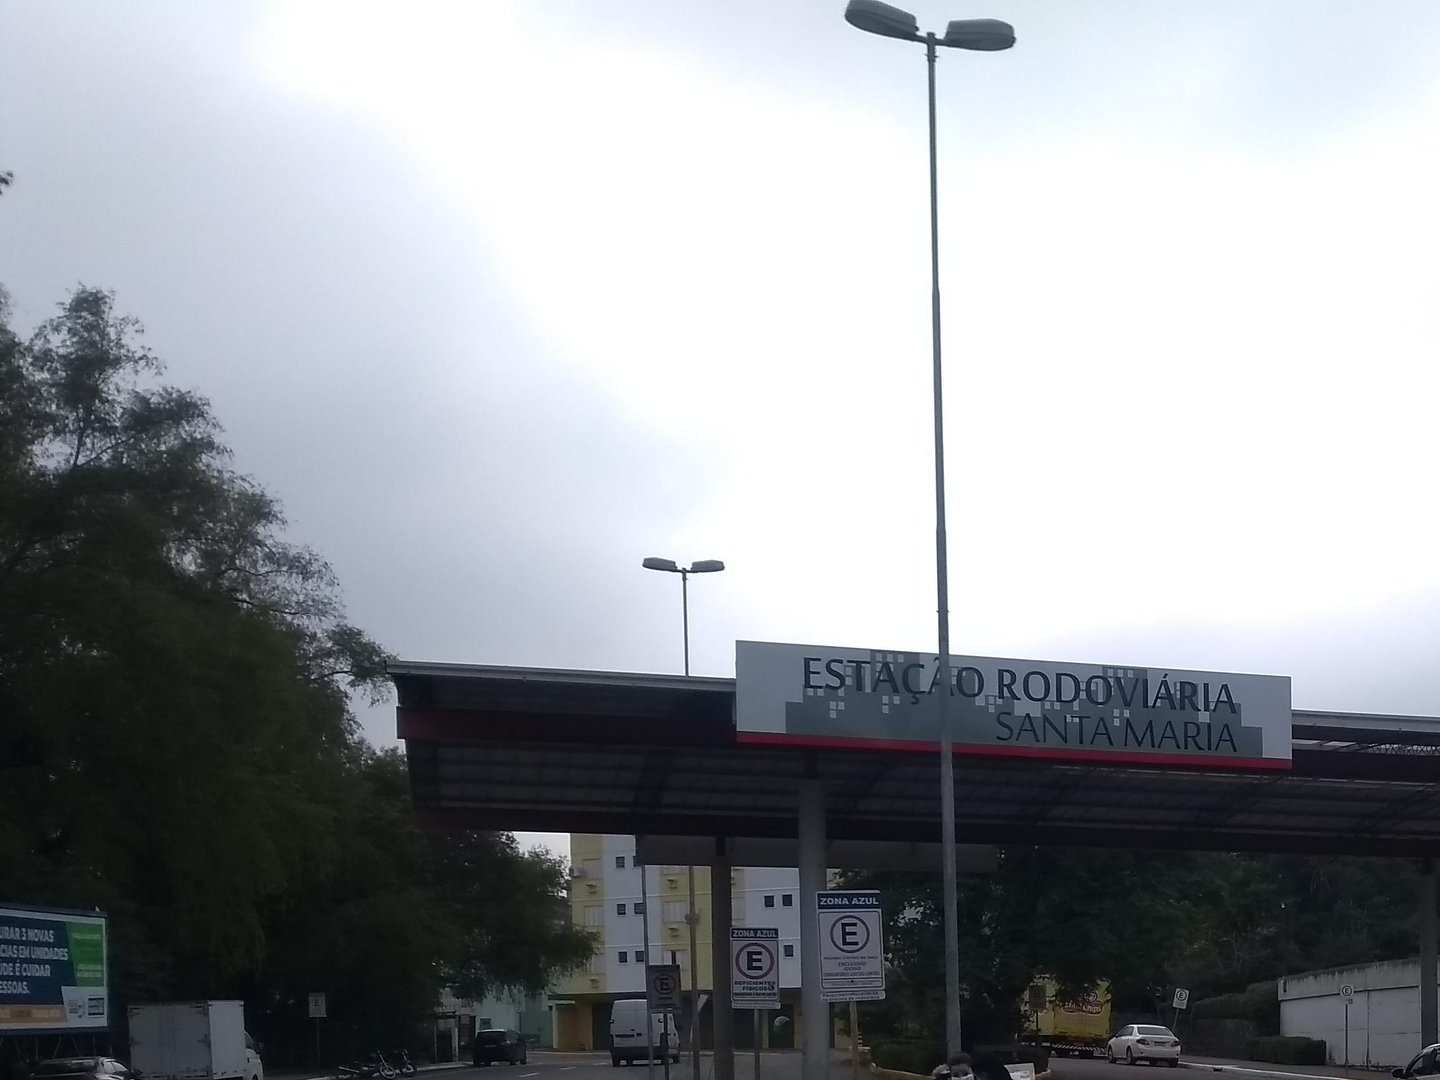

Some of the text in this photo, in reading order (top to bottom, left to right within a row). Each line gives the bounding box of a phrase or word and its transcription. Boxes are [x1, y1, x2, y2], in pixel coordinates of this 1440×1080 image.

[803, 656, 1238, 714] ESTAÇÃO RODOVIÁRIA
[996, 711, 1239, 752] SANTA MARIA
[820, 897, 879, 906] ZONA AZUL
[21, 927, 26, 941] 3
[27, 928, 55, 943] NOVAS
[733, 929, 777, 938] ZONA AZUL
[841, 922, 859, 946] E
[747, 951, 763, 971] E
